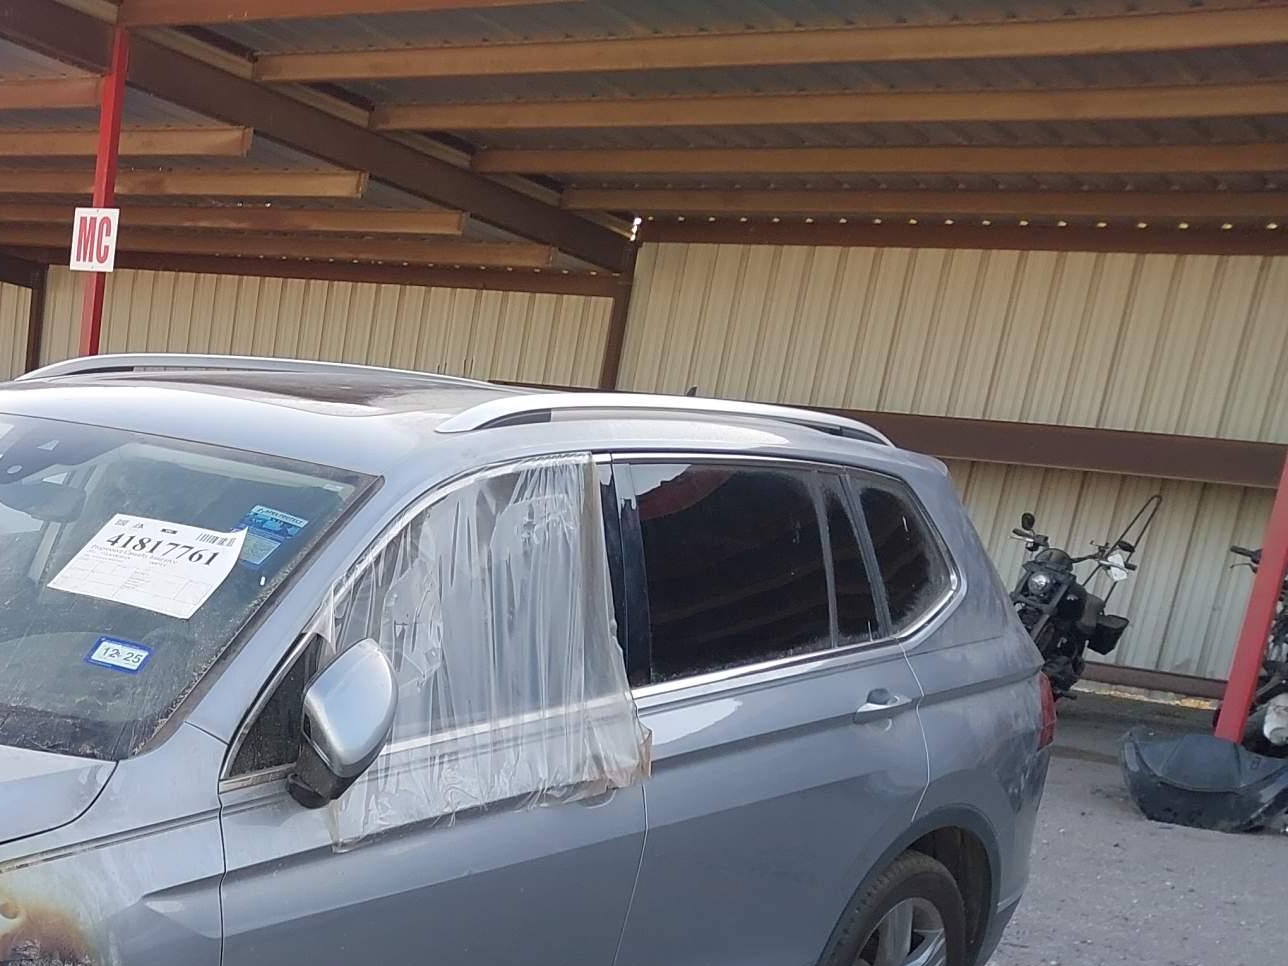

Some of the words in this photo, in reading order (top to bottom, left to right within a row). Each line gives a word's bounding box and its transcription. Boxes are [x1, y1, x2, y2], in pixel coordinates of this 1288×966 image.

[75, 215, 112, 264] MC
[106, 532, 220, 567] 41817761
[123, 651, 143, 664] 25
